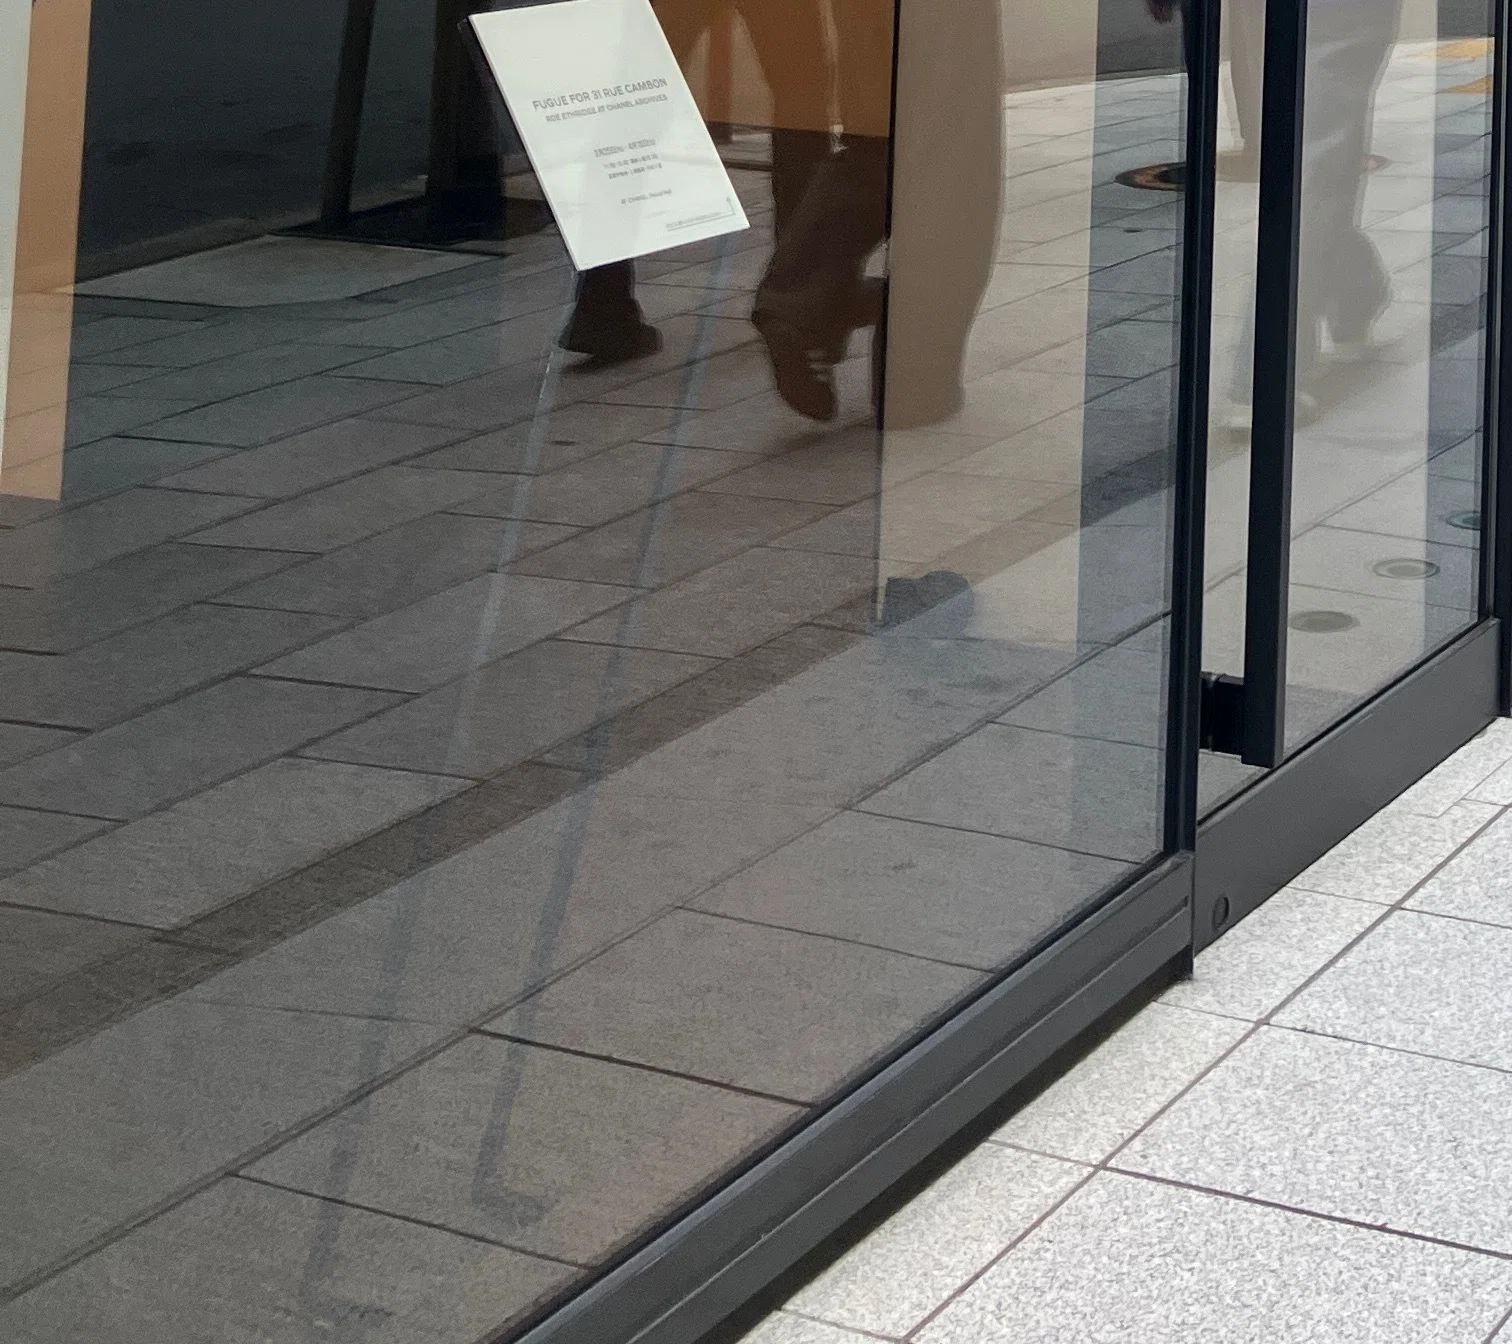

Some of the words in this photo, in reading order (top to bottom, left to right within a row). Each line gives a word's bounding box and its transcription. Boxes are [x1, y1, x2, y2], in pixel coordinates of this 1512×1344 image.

[532, 95, 569, 111] FUGUE
[569, 91, 591, 105] FOR
[591, 89, 603, 101] 31
[603, 85, 625, 99] RUE
[625, 78, 668, 94] CAMBON
